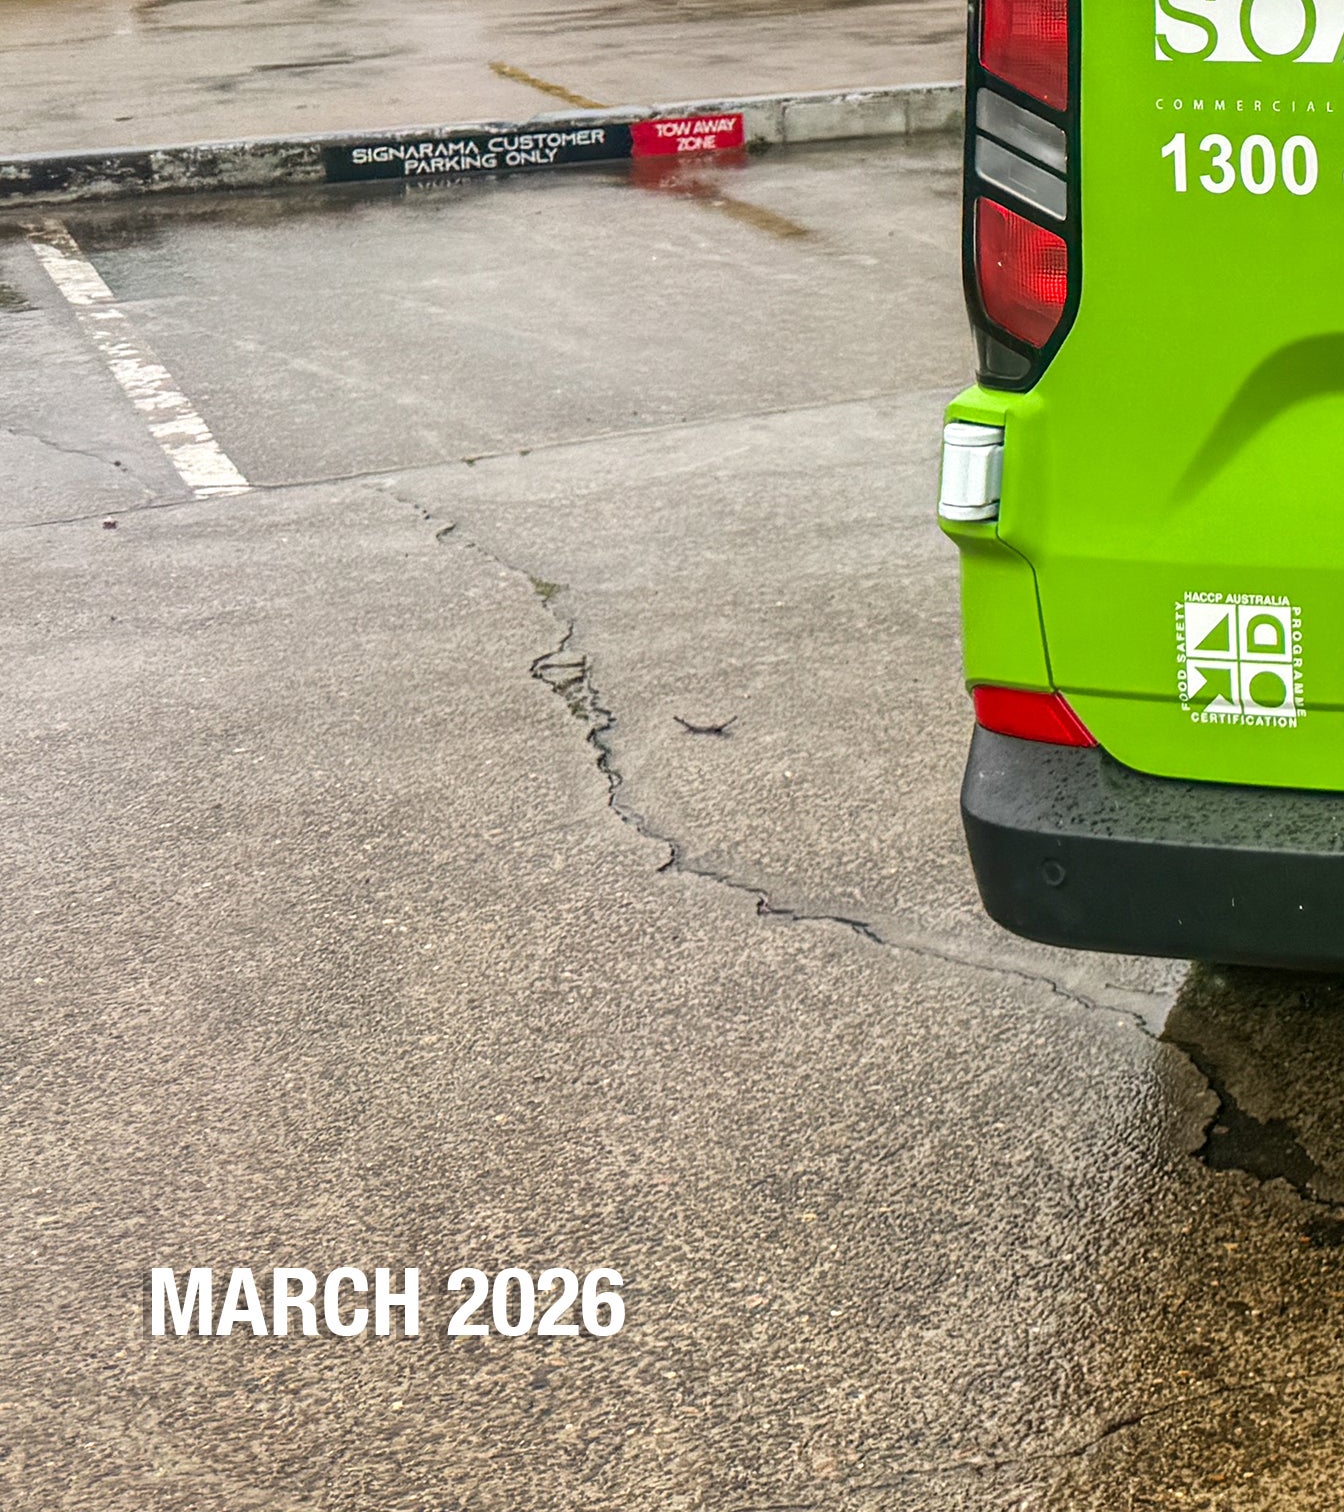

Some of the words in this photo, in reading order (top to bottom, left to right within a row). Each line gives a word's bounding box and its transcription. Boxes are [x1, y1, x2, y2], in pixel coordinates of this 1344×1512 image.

[1156, 98, 1334, 113] COMMERCIAL
[655, 121, 693, 139] TOW
[694, 117, 738, 135] AWAY
[352, 141, 479, 163] SIGNARAMA
[488, 130, 605, 154] CUSTOMER
[677, 134, 717, 151] ZONE
[404, 153, 498, 176] PARKING
[506, 148, 558, 166] ONLY
[1160, 133, 1318, 195] 1300
[1184, 591, 1222, 602] HACCP
[1226, 594, 1290, 606] AUSTRALIA
[1175, 601, 1186, 662] SAFETY
[1177, 670, 1190, 711] FOOD
[1191, 712, 1297, 728] CERTIFICATION
